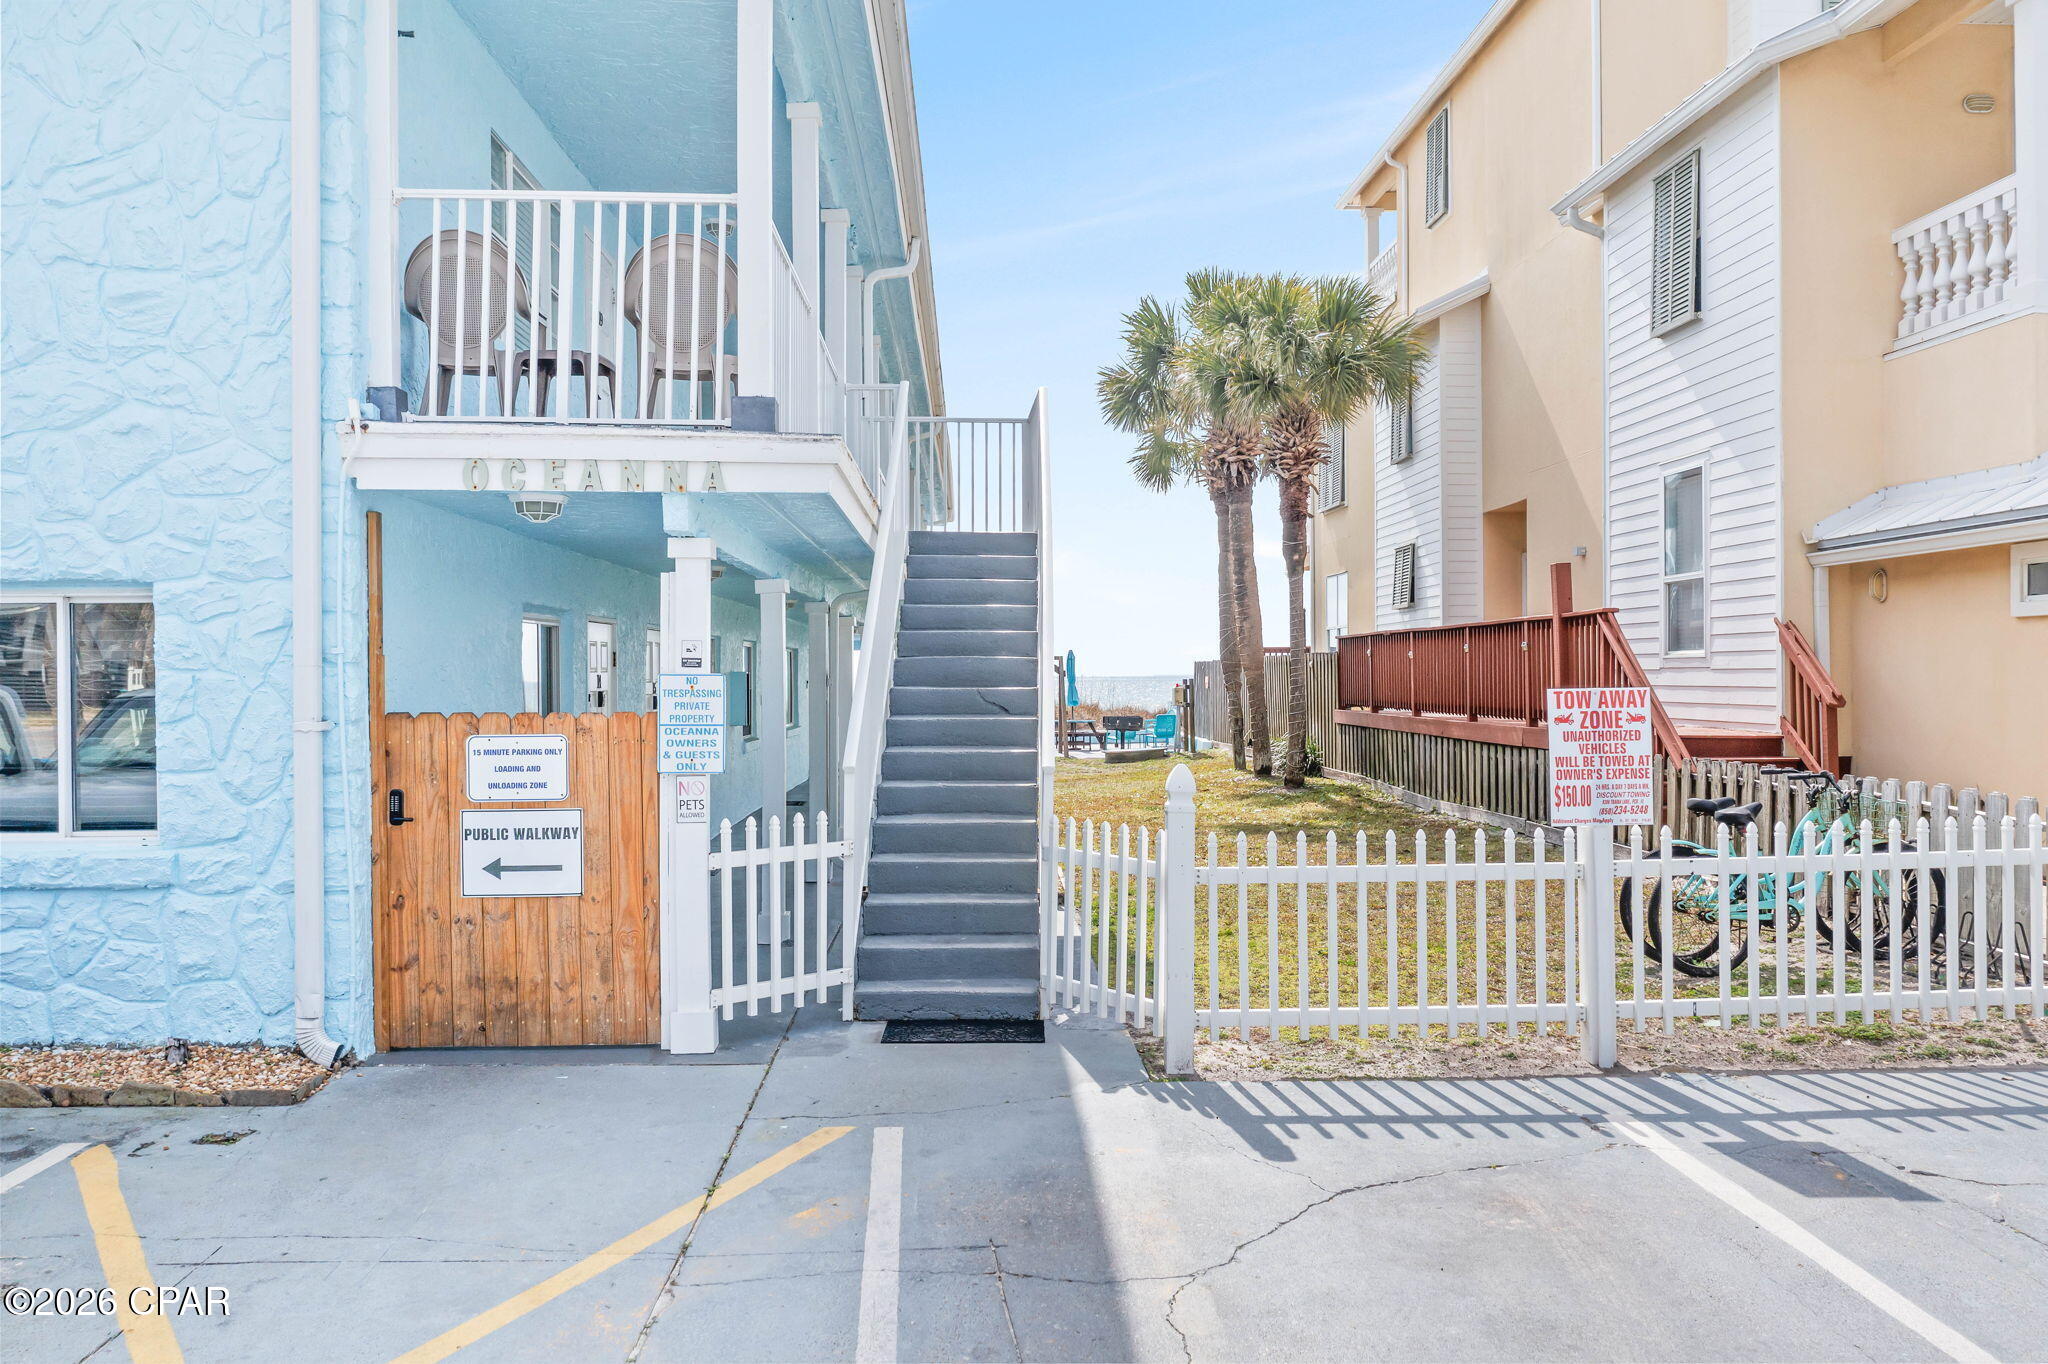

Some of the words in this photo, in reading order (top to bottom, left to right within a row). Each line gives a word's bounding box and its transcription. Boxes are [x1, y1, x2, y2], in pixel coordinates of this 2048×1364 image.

[462, 457, 726, 493] OCEANNA
[686, 677, 698, 685] NO
[662, 689, 722, 698] TRESPASSING
[1553, 690, 1592, 710] TOW
[1597, 689, 1647, 709] AWAY
[674, 702, 710, 711] PRIVATE
[669, 714, 715, 723] PROPERTY
[1579, 710, 1624, 730] ZONE
[664, 727, 719, 736] OCEANNA
[1562, 729, 1642, 742] UNAUTHORIZED
[666, 739, 717, 748] OWNERS
[511, 748, 543, 756] PARKING
[544, 748, 563, 756] ONLY
[1578, 742, 1627, 755] VEHICLES
[662, 751, 671, 759] &
[675, 751, 720, 759] GUESTS
[1554, 756, 1580, 768] WILL
[1582, 756, 1595, 768] BE
[1597, 755, 1635, 767] TOWED
[1637, 755, 1651, 766] AT
[494, 765, 525, 773] LOADING
[676, 762, 707, 771] ONLY
[1556, 768, 1603, 781] OWNER'S
[1606, 768, 1651, 780] EXPENSE
[488, 782, 528, 790] UNLOADING
[529, 781, 548, 789] ZONE
[1554, 782, 1592, 813] $150.00
[679, 799, 705, 810] PETS
[679, 811, 705, 819] ALLOWED
[464, 828, 509, 841] PUBLIC
[513, 826, 579, 841] WALKWAY
